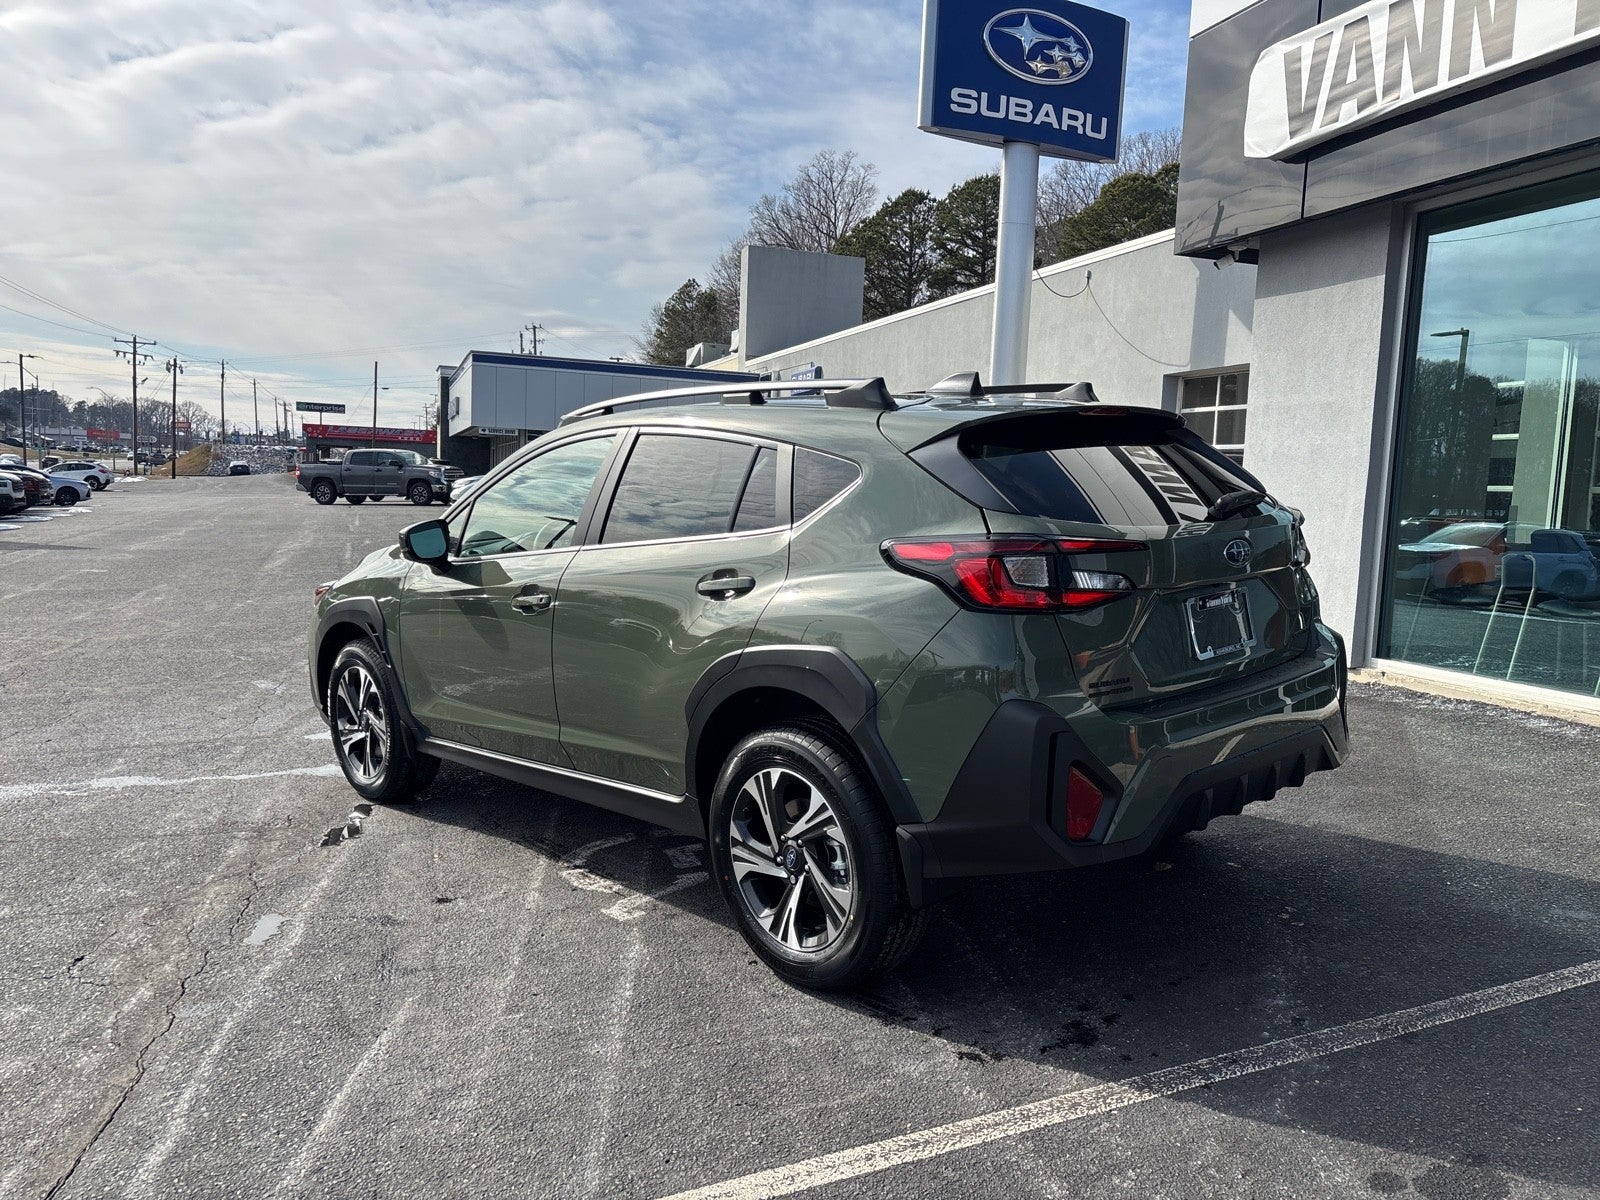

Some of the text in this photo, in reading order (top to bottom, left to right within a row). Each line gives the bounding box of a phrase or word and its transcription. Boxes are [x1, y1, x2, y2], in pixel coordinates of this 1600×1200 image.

[1283, 0, 1518, 140] VANN
[950, 87, 1108, 140] SUBARU
[298, 403, 345, 412] enterprise
